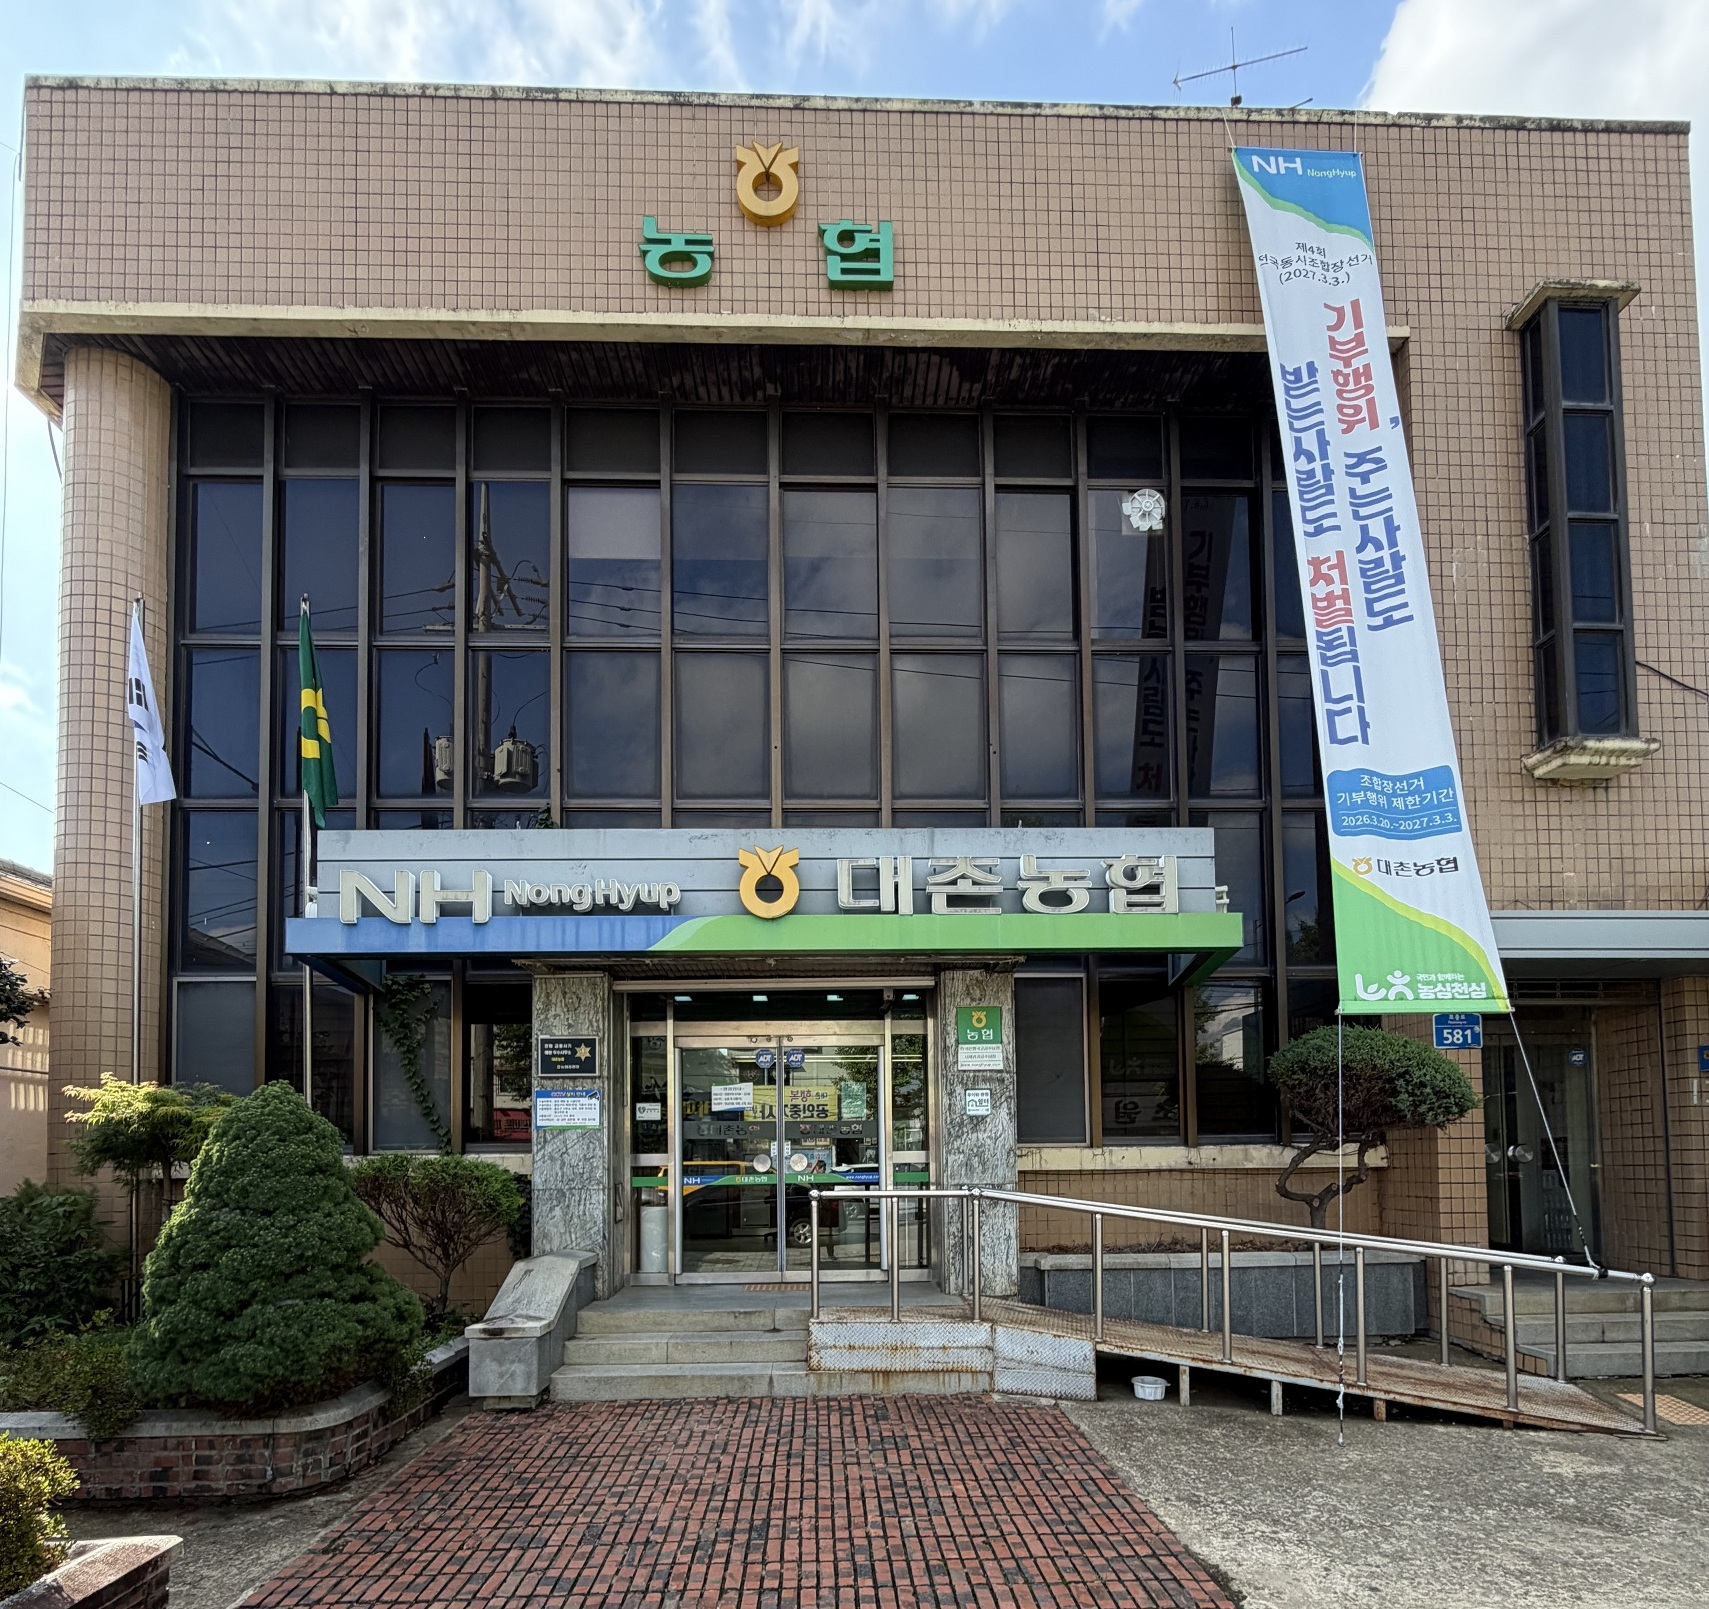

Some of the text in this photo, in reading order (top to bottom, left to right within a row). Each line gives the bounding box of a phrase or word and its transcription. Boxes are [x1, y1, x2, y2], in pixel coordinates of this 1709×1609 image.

[1252, 155, 1357, 178] NH NongHyup
[1295, 241, 1327, 259] 제4회
[1279, 268, 1351, 286] (2027.3.3.)
[1344, 445, 1415, 632] 주는사람도
[1279, 361, 1371, 746] 받는사람도 처벌됩니다
[1336, 788, 1455, 810] 기부행위 제한기간
[1376, 856, 1460, 878] 대촌농협
[837, 852, 1180, 915] 대촌농협
[339, 869, 682, 924] NH NongHyup
[1417, 982, 1488, 999] 농심천심
[966, 1029, 993, 1041] 농협
[1443, 1029, 1472, 1044] 581
[758, 1055, 772, 1063] ADT
[788, 1054, 803, 1062] ADT
[797, 1174, 814, 1182] NH
